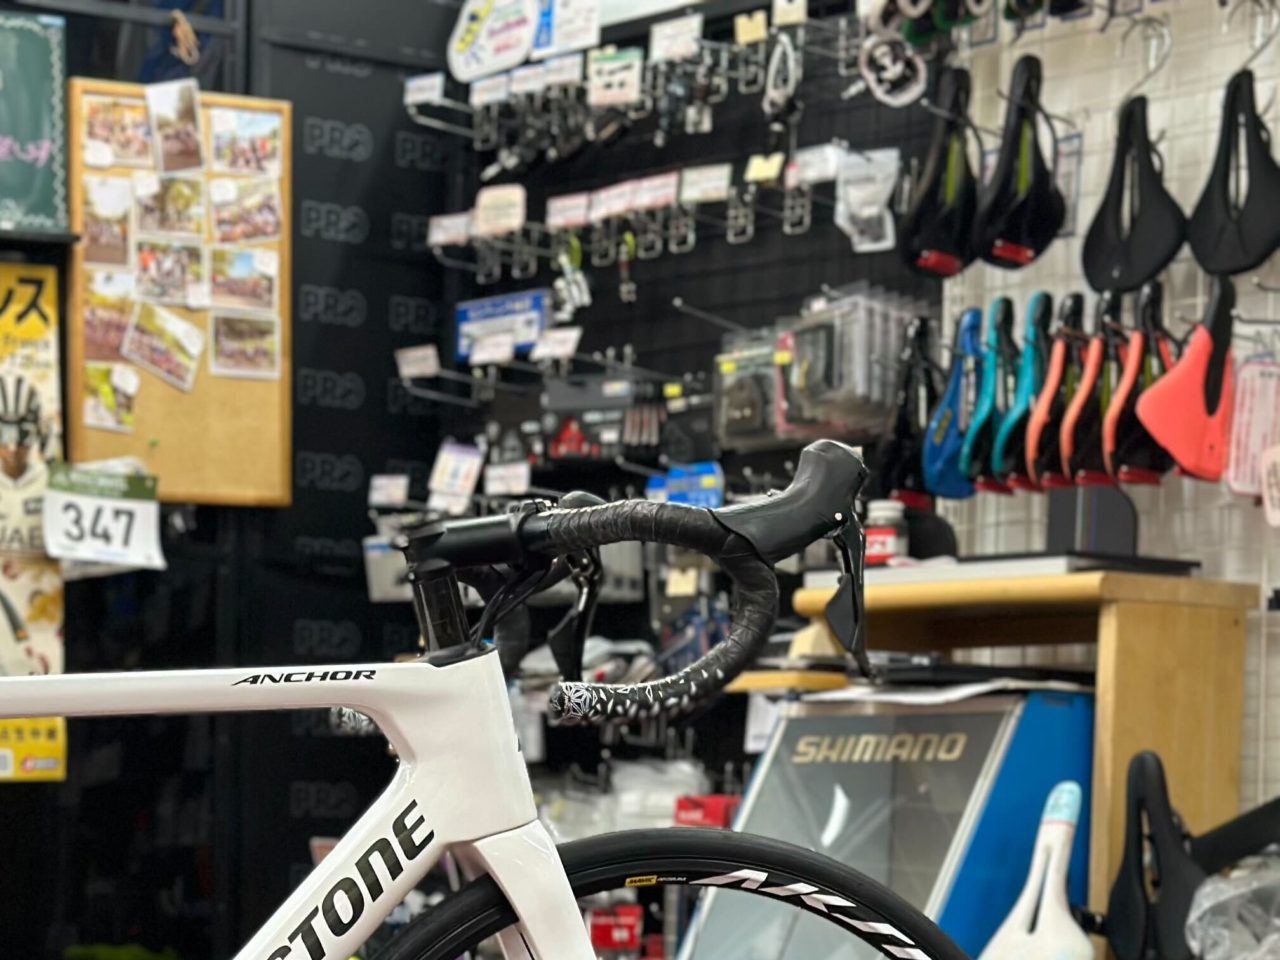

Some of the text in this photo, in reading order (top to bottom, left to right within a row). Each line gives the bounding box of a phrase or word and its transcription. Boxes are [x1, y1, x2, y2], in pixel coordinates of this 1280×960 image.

[63, 502, 136, 548] 347
[231, 669, 377, 686] ANCHOR
[792, 732, 967, 763] SHIMANO
